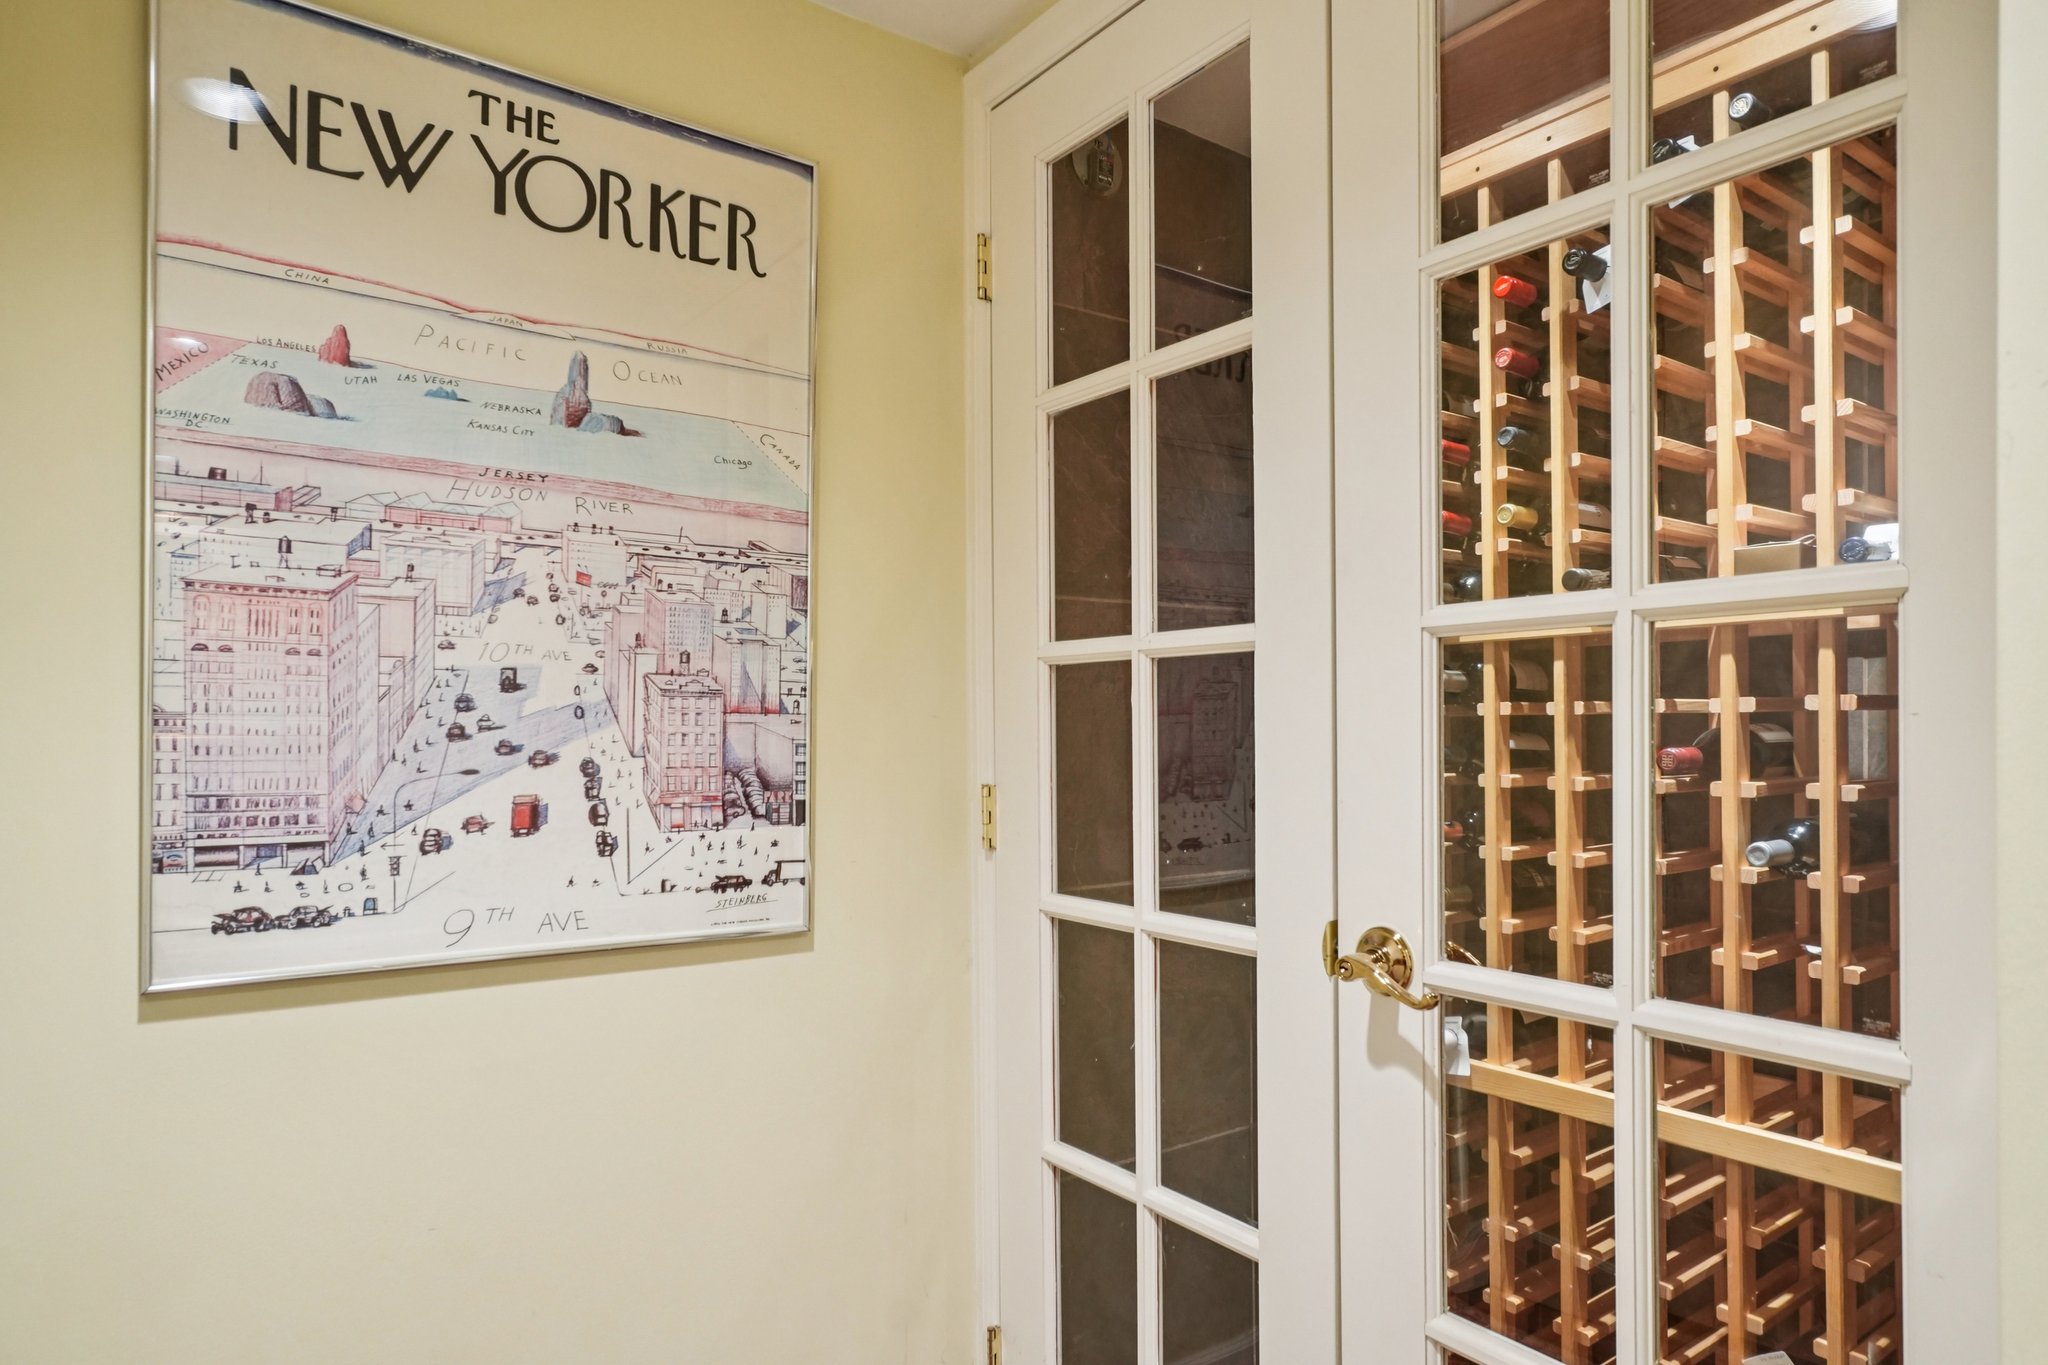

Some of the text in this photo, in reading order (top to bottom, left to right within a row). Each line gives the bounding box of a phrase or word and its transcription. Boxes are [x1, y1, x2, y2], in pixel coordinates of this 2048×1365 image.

[467, 89, 560, 145] THE
[228, 66, 767, 278] NEW YORKER
[284, 269, 329, 285] CHINA
[489, 316, 524, 327] JAPAN
[256, 336, 317, 353] LOS ANGELES
[647, 342, 689, 354] RUSSIA
[155, 342, 209, 381] MEXICO
[231, 353, 279, 369] TEXAS
[414, 323, 683, 386] PACIFIC OCEAN
[344, 375, 378, 386] UTAH
[397, 373, 461, 388] LAS VEGAS
[154, 408, 231, 424] WASHINGTON
[480, 401, 542, 416] NEBRASKA
[466, 418, 535, 437] KANSAS CITY
[760, 434, 801, 471] CANADA
[714, 455, 753, 469] Chicago
[479, 467, 550, 483] JERSEY
[447, 479, 633, 516] HUDSON RIVER
[478, 642, 573, 663] 10TH AVE
[715, 893, 768, 909] STEINBERG
[443, 906, 590, 949] 9TH AVE
